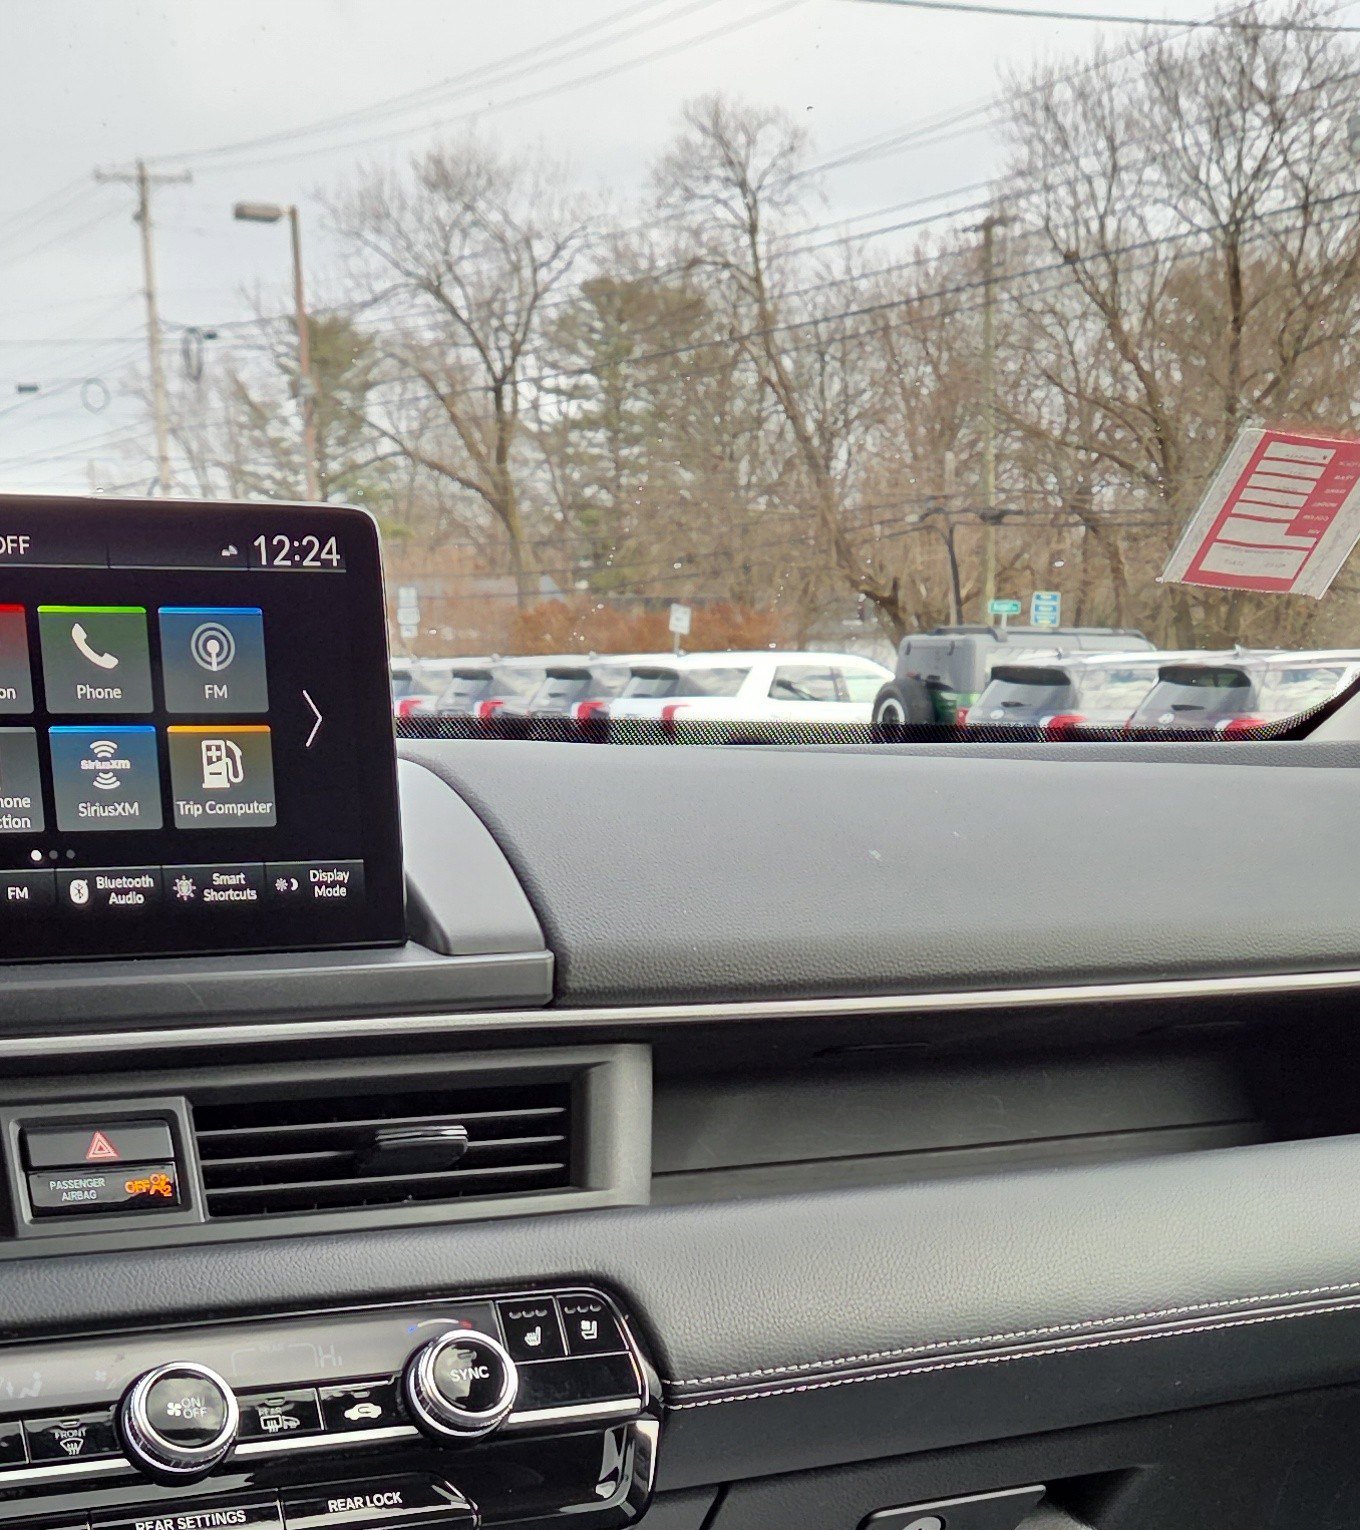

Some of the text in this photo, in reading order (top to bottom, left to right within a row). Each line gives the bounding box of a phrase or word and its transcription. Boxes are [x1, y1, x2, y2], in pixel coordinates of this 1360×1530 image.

[253, 535, 341, 567] 12:24
[76, 684, 122, 699] Phone
[204, 685, 228, 698] FM
[78, 801, 139, 817] SiriusXM
[176, 800, 273, 817] Trip Computer
[96, 874, 154, 889] Bluetooth
[212, 872, 246, 885] Smart
[309, 868, 350, 884] Display
[7, 887, 29, 900] FM
[108, 891, 144, 905] Audio
[203, 887, 257, 902] Shortcuts
[314, 885, 347, 898] Mode
[49, 1178, 106, 1191] PASSENGER
[62, 1190, 97, 1202] AIRBAG
[449, 1365, 490, 1382] SYNC
[183, 1406, 208, 1419] OFF
[55, 1428, 87, 1441] FRONT
[328, 1491, 403, 1513] REAR LOCK
[177, 1510, 247, 1530] SETTINGS
